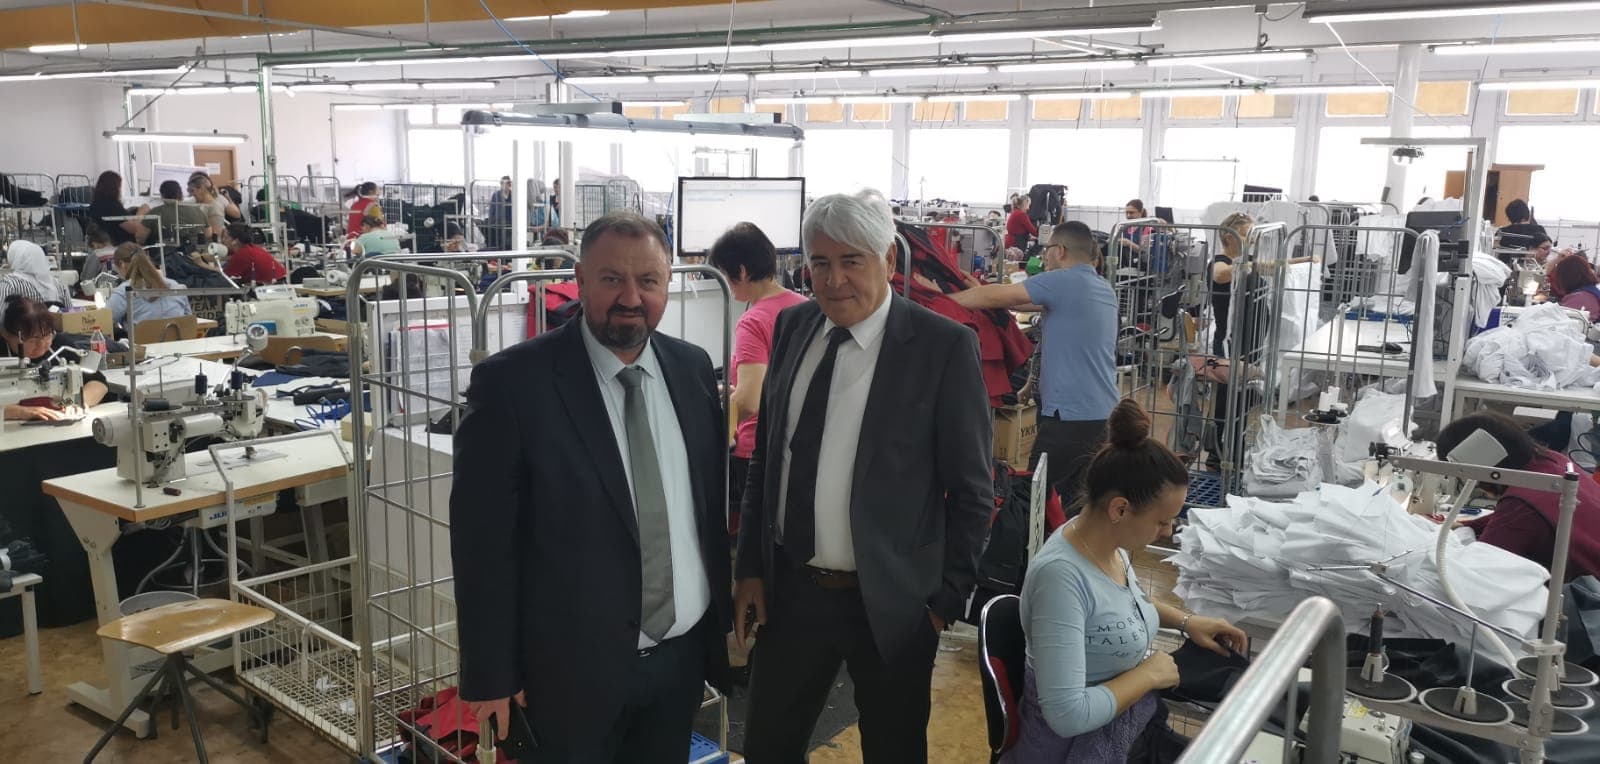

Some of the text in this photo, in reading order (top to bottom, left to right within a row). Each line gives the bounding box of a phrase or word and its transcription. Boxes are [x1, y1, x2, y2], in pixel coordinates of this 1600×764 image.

[191, 302, 216, 311] EAR
[1097, 611, 1139, 632] MORE
[1085, 626, 1145, 645] TALEN
